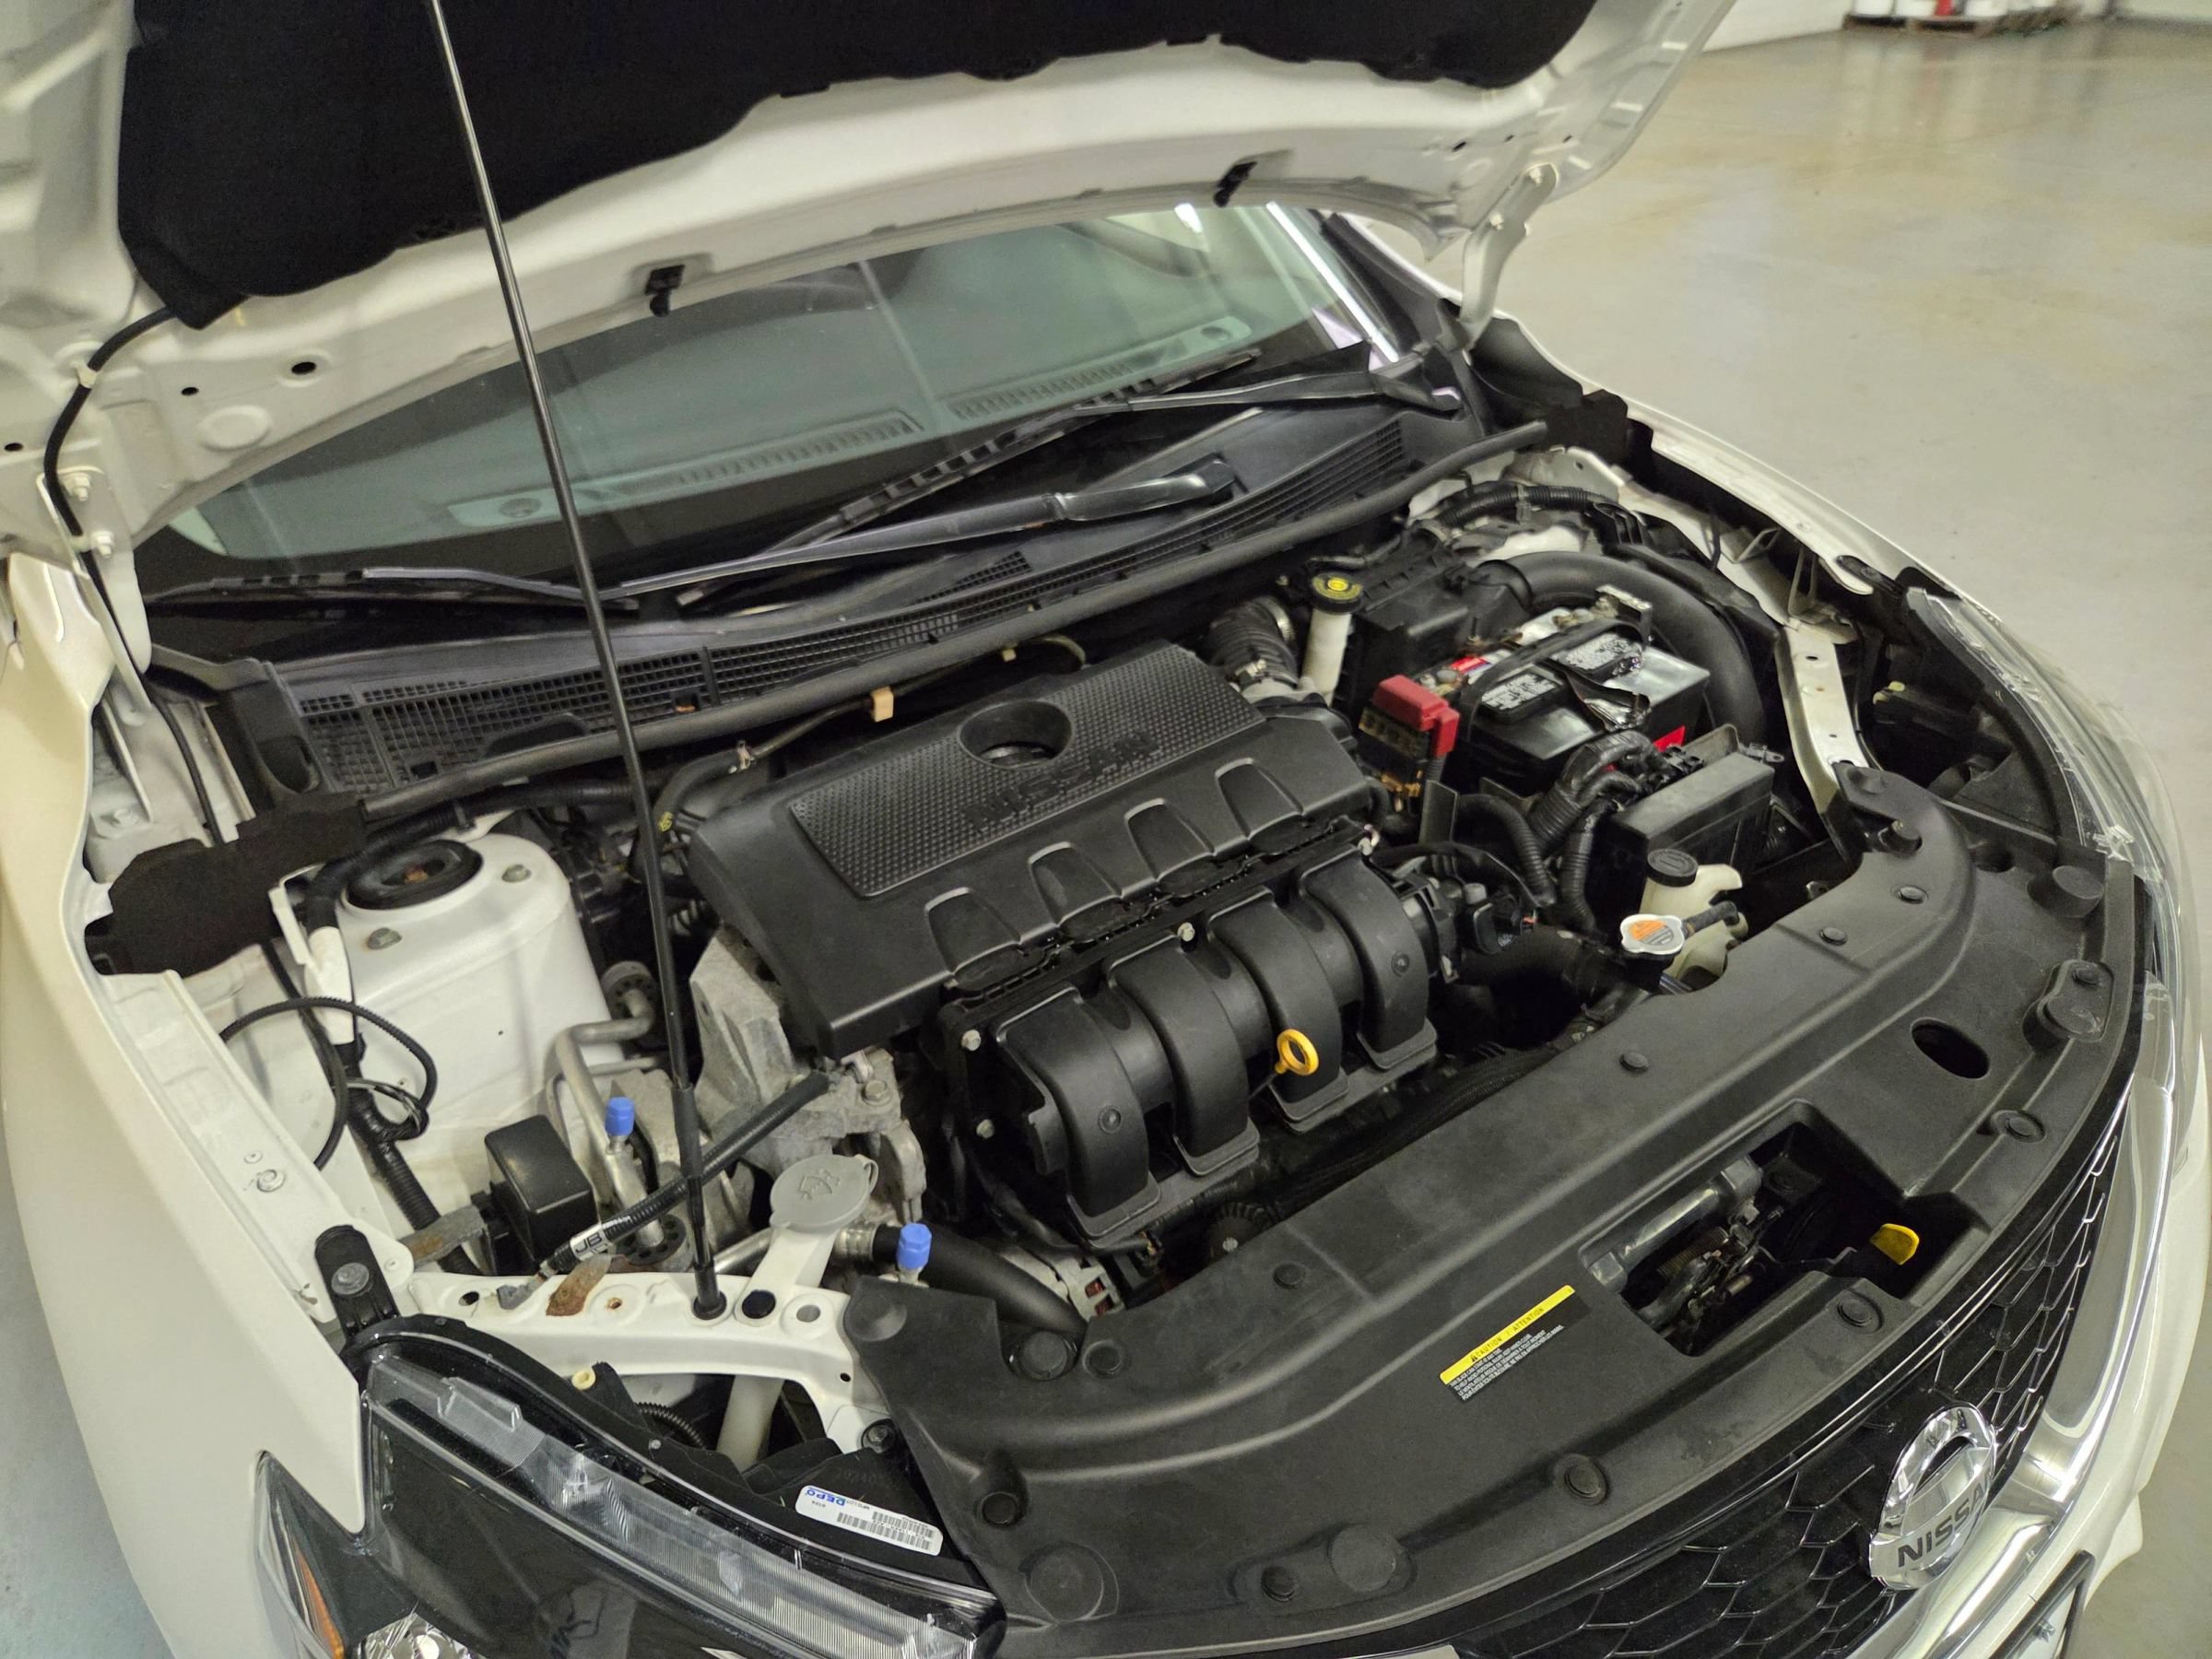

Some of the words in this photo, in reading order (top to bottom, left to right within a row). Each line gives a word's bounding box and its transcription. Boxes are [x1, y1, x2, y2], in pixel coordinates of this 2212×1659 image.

[963, 733, 1162, 830] NISSAN
[1477, 1337, 1502, 1357] CAUTION
[1512, 1307, 1544, 1331] ATTENTION
[807, 1489, 845, 1506] DEPO
